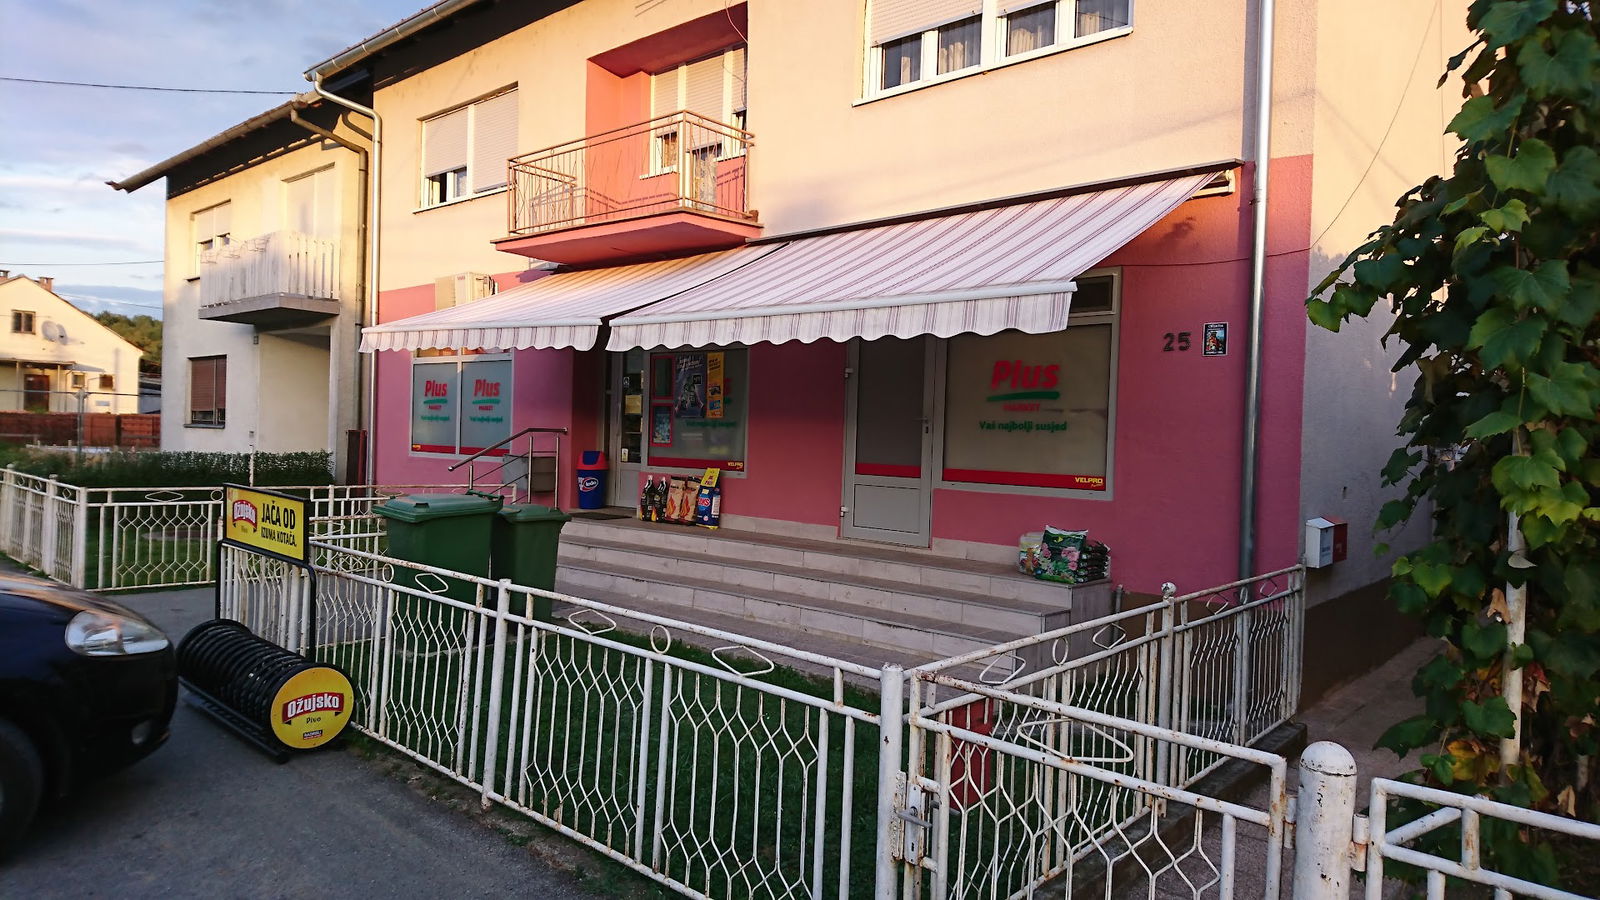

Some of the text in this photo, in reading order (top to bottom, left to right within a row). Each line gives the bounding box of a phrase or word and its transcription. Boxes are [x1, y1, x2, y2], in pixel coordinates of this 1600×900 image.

[1163, 332, 1192, 352] 25
[990, 359, 1061, 390] Plus
[424, 380, 448, 397] Plus
[473, 379, 501, 397] Plus
[998, 420, 1034, 432] najbolji
[1035, 420, 1068, 432] susjed
[1074, 476, 1104, 484] VELPRO
[234, 501, 256, 524] Ožujsko
[261, 500, 296, 530] JAČA OD
[261, 526, 277, 541] IZUMA
[287, 693, 340, 718] Ožujsko
[306, 716, 322, 724] Pivo
